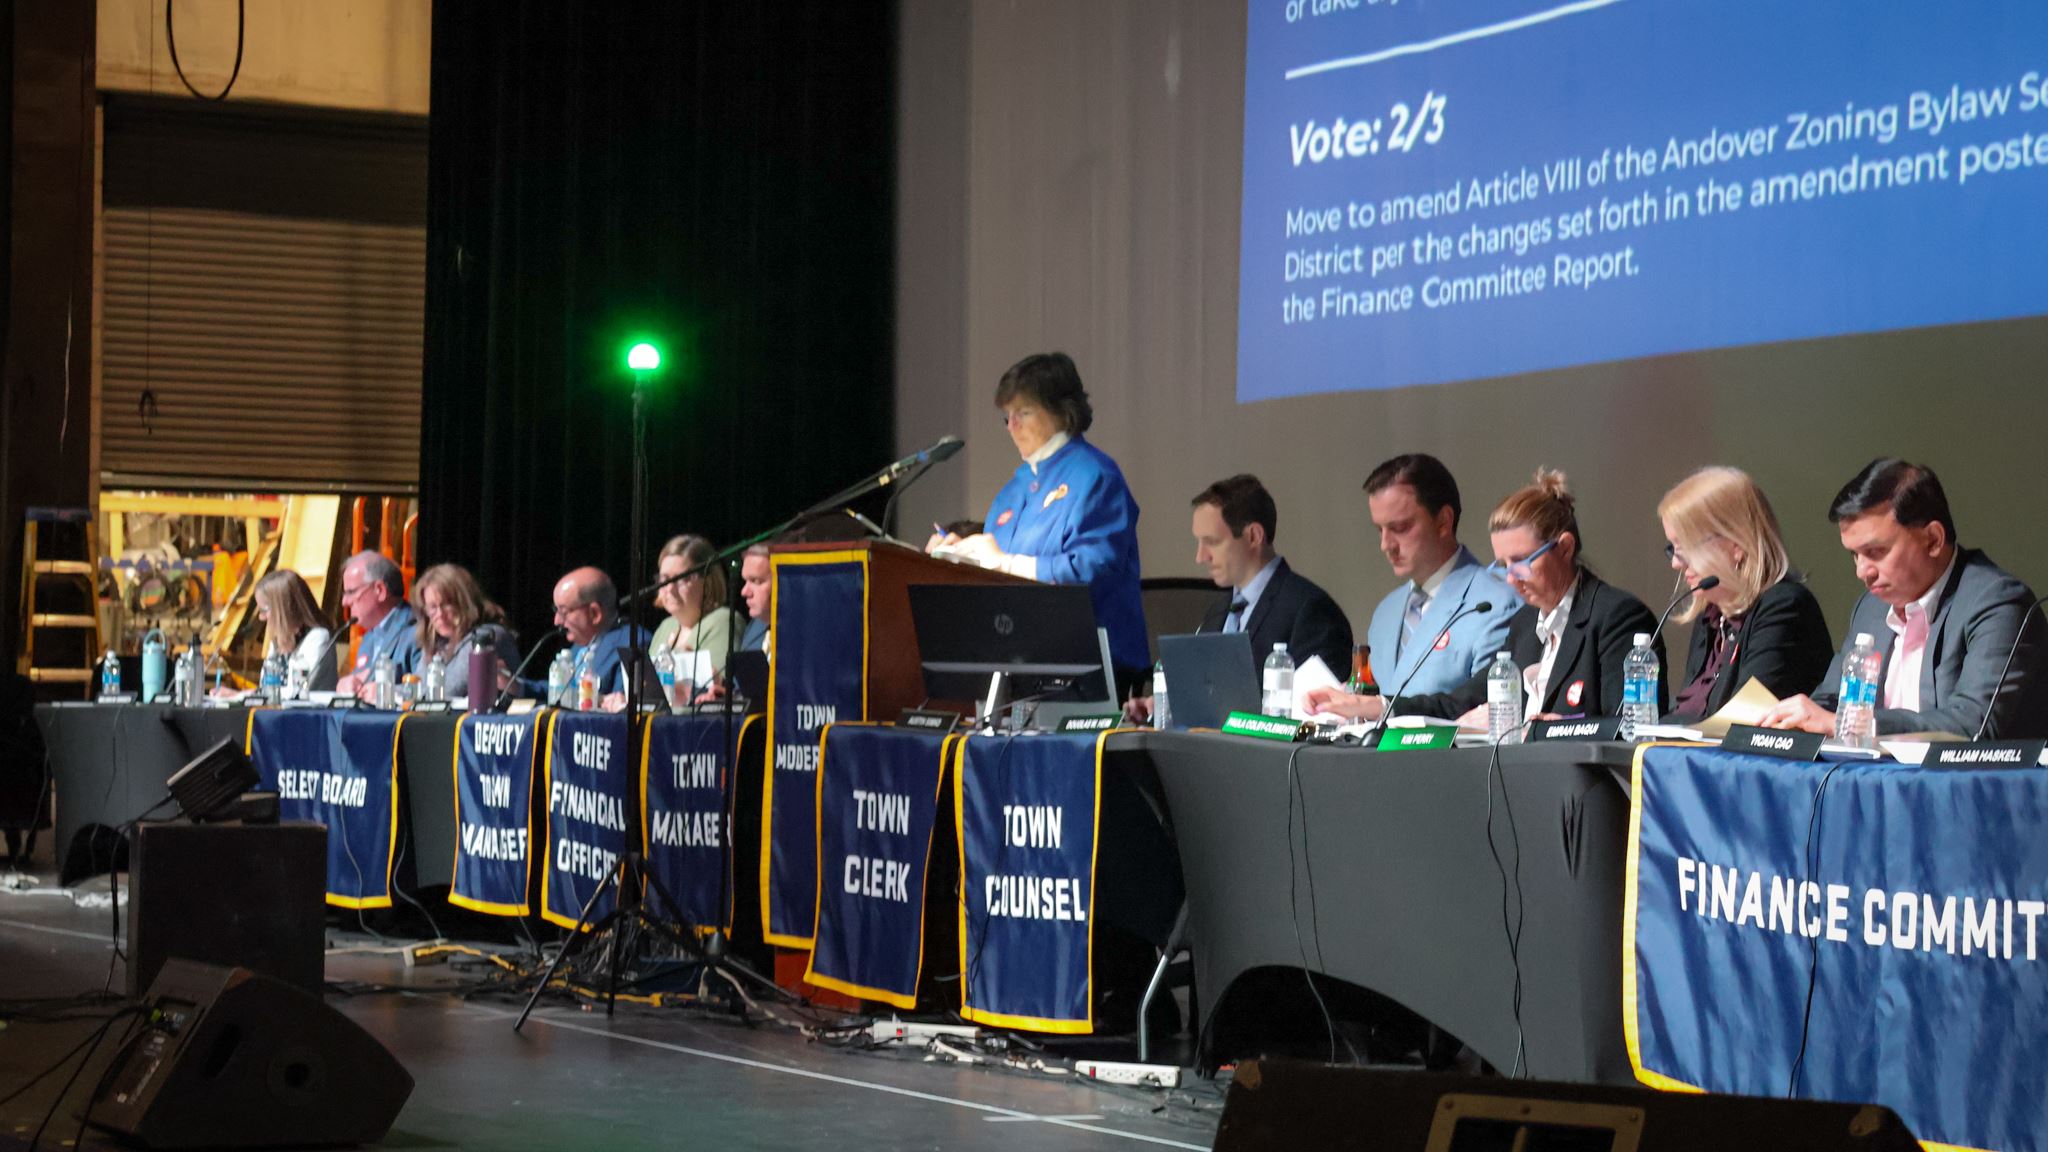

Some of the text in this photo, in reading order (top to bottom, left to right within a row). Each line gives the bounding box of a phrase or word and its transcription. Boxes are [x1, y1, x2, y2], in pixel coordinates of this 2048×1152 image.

[1290, 90, 1447, 167] Vote: 2/3
[1286, 206, 1341, 238] Move
[1347, 202, 1375, 229] to
[1381, 182, 1460, 223] amend
[1466, 171, 1539, 209] Article
[1543, 157, 1581, 194] VIII
[1587, 148, 1610, 187] of
[1615, 145, 1656, 182] the
[1661, 124, 1779, 172] Andover
[1786, 101, 1898, 150] Zoning
[1908, 84, 2012, 136] Bylaw
[1285, 245, 1364, 282] District
[1371, 241, 1405, 278] per
[1413, 232, 1451, 265] the
[1458, 218, 1551, 256] changes
[1557, 207, 1593, 241] set
[1599, 191, 1658, 232] forth
[1665, 186, 1688, 221] in
[1696, 179, 1743, 217] the
[1750, 145, 1949, 207] amendment
[1283, 246, 1640, 324] the Finance Committee Report.
[797, 704, 835, 730] TOWN
[474, 721, 524, 756] DEPUTY
[573, 731, 612, 771] CHIEF
[775, 744, 820, 771] MODER
[1940, 748, 2022, 762] WILLIAM HASKELL
[278, 769, 367, 807] SELECT BOARD
[479, 773, 511, 808] TOWN
[672, 753, 716, 789] TOWN
[652, 810, 734, 848] MANAGE
[853, 789, 910, 835] TOWN
[1003, 804, 1062, 848] TOWN
[843, 854, 911, 903] CLERK
[985, 874, 1086, 921] COUNSEL
[1677, 856, 1850, 942] FINANCE
